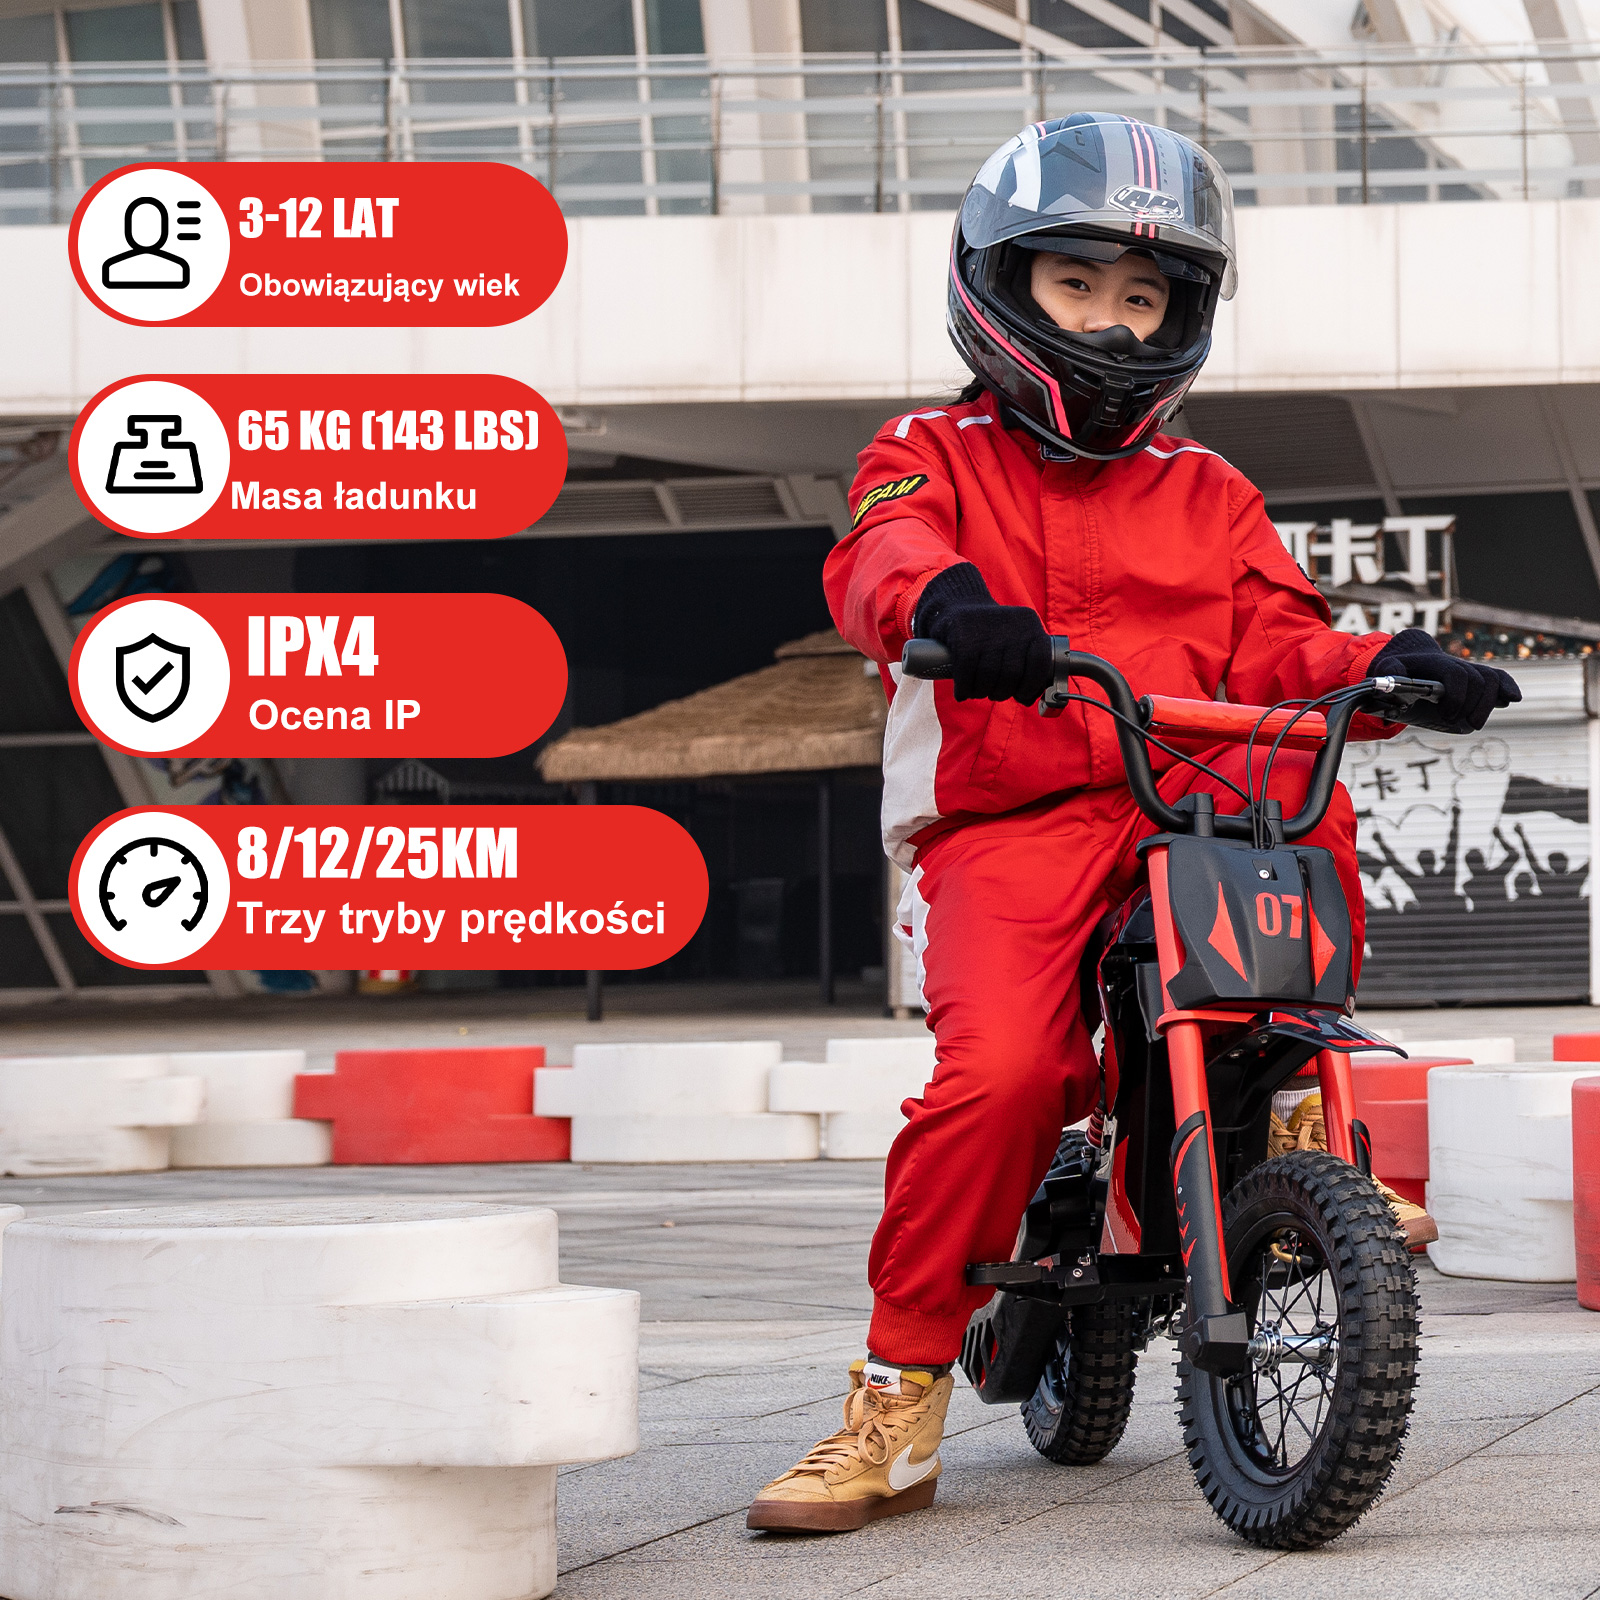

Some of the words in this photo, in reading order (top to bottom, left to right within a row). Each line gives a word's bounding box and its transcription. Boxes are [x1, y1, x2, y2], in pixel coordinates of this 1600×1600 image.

[1360, 757, 1442, 801] 卡丁
[1254, 891, 1303, 940] 07
[870, 1373, 890, 1385] NIKE
